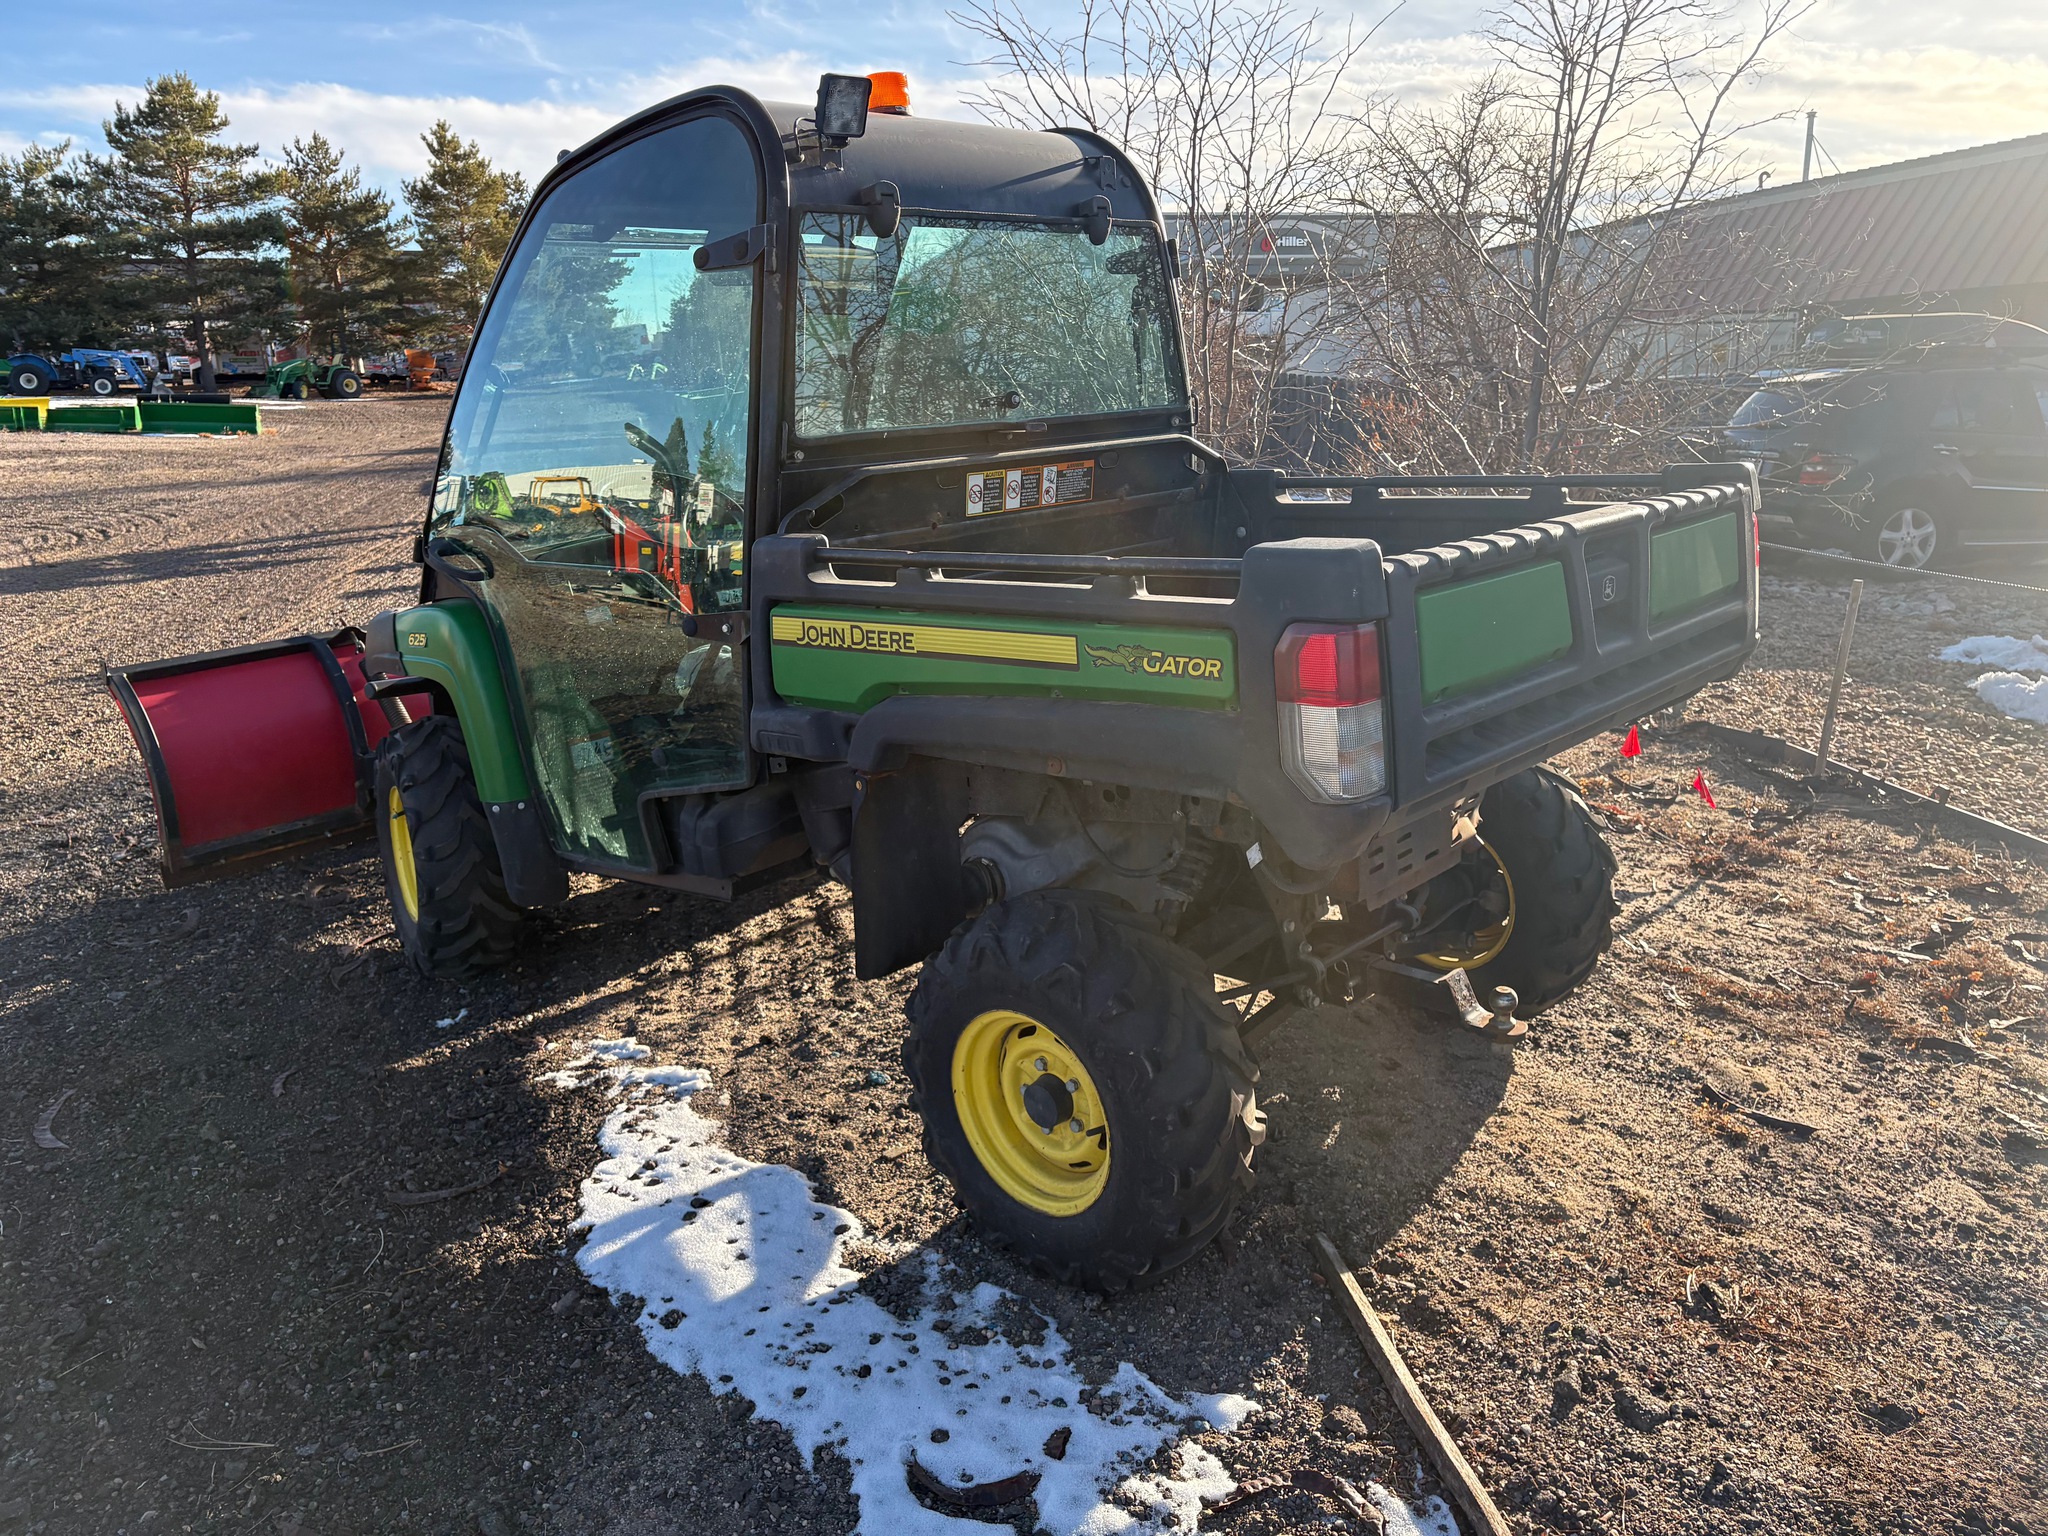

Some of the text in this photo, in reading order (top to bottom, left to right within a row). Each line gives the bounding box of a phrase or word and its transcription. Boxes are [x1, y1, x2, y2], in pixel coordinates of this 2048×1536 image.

[796, 621, 916, 651] JOHN DEERE
[1142, 651, 1222, 678] GATOR
